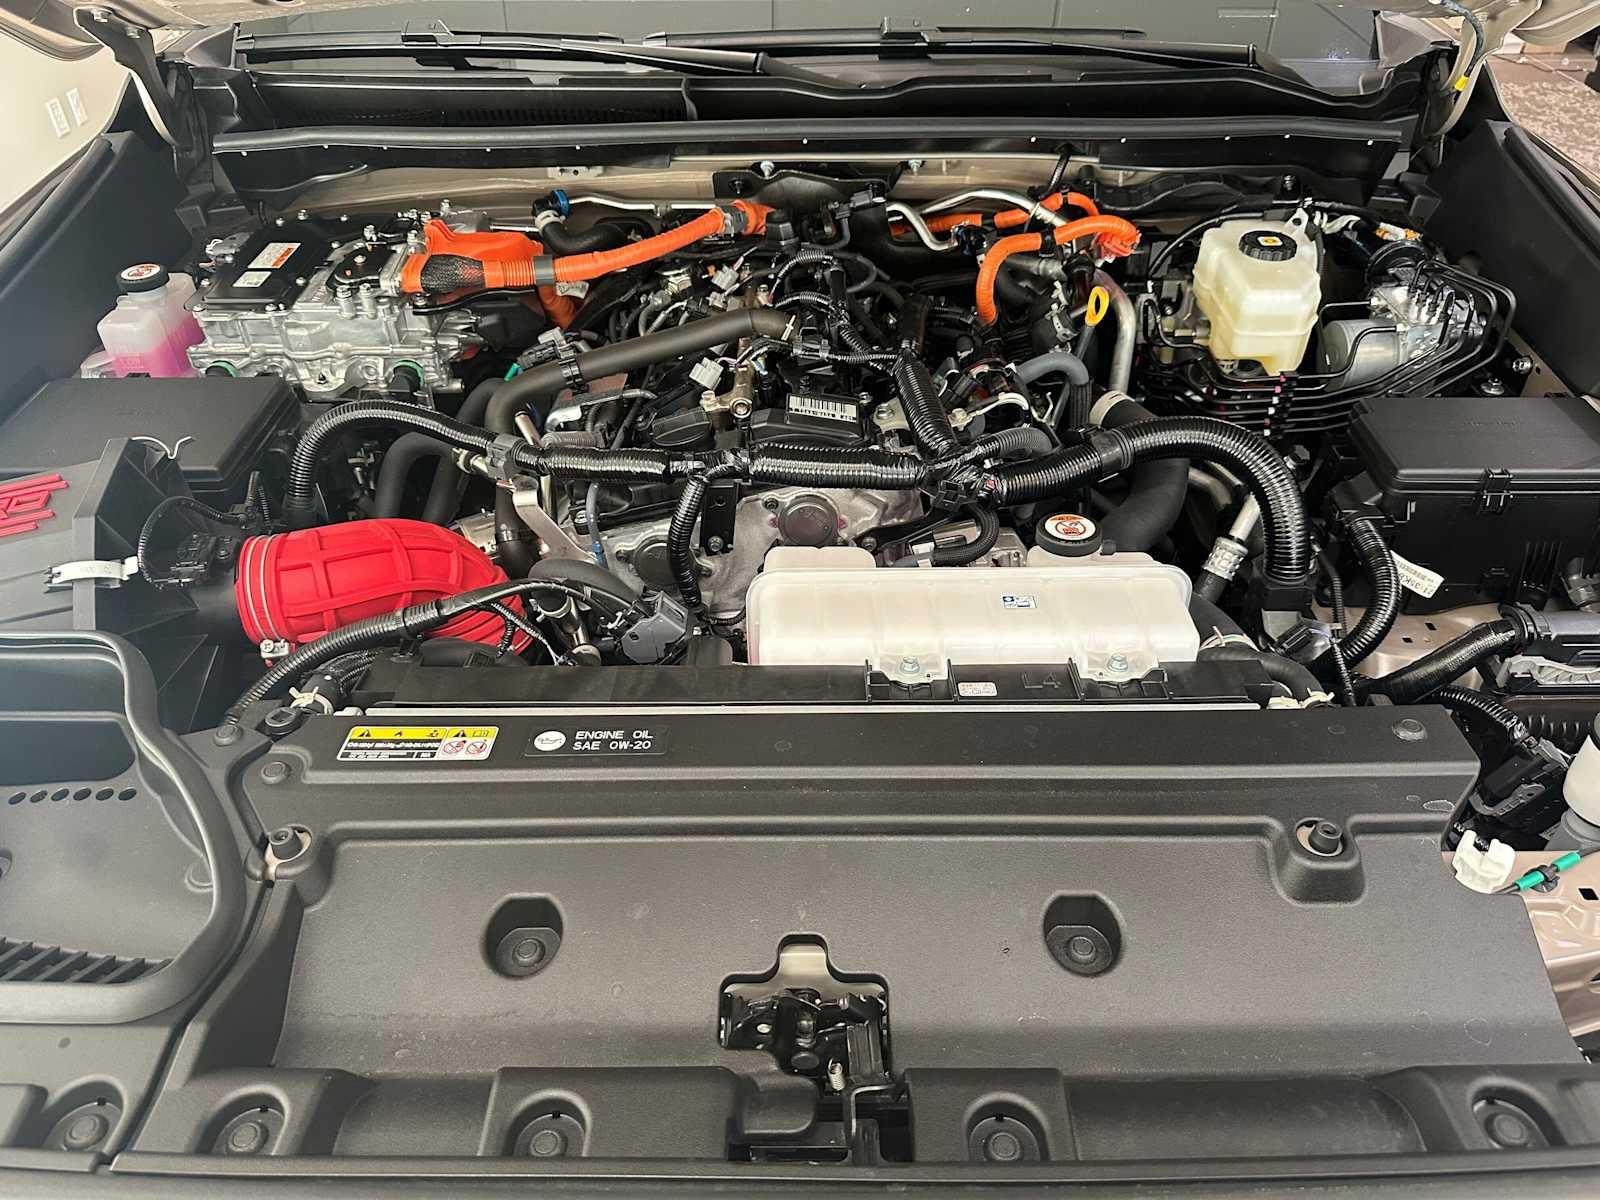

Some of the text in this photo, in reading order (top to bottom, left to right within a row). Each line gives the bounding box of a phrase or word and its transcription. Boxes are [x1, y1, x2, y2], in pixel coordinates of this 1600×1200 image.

[575, 729, 654, 740] ENGINE OIL
[572, 740, 652, 751] SAE 0W-20
